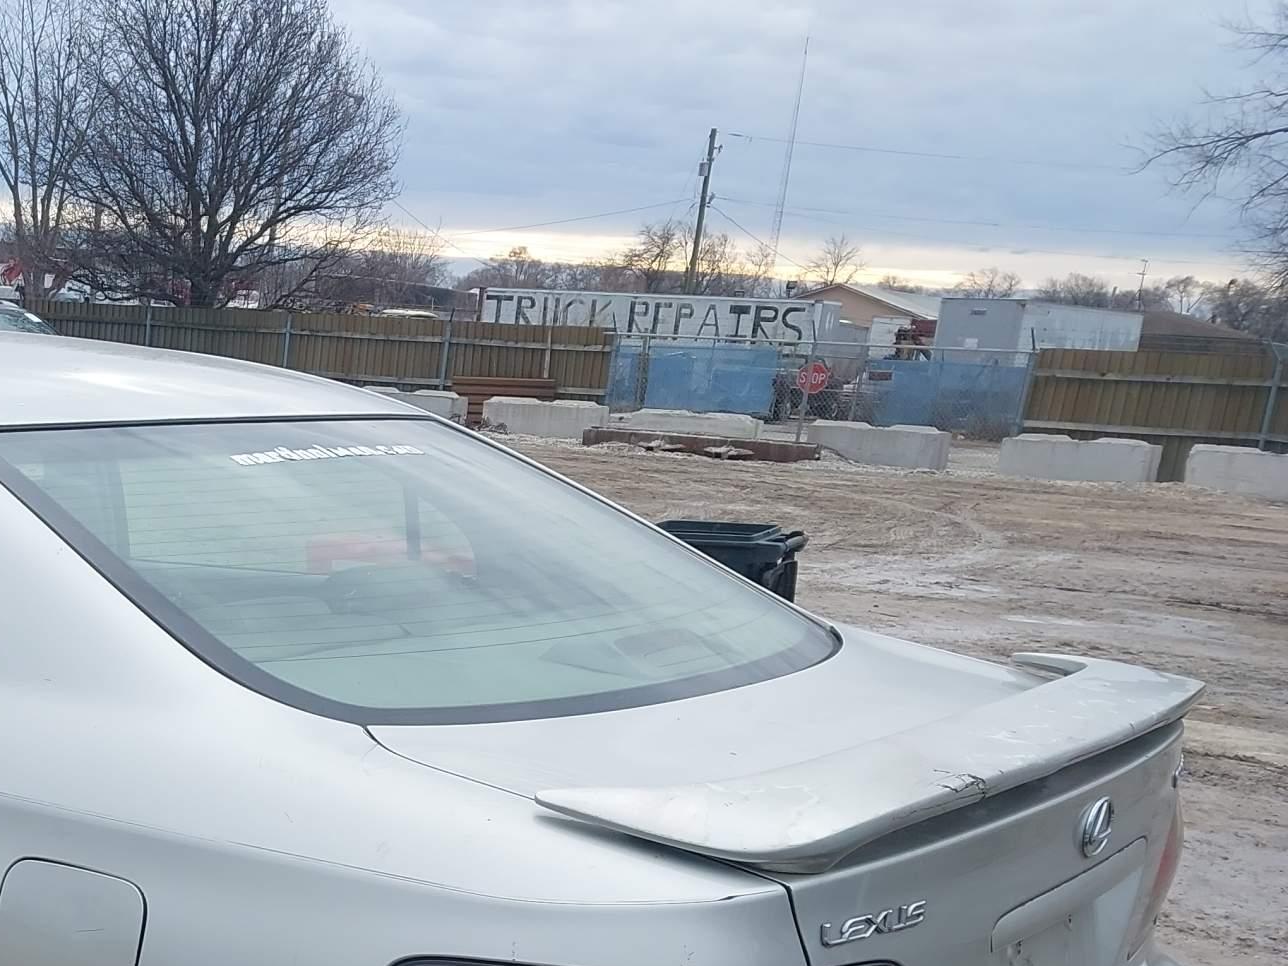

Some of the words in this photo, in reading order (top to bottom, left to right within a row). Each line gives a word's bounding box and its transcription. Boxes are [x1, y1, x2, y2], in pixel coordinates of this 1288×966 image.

[486, 294, 611, 326] TRUCK
[627, 300, 806, 346] REPAIRS
[799, 371, 826, 384] SOP
[820, 900, 926, 947] LEXUS
